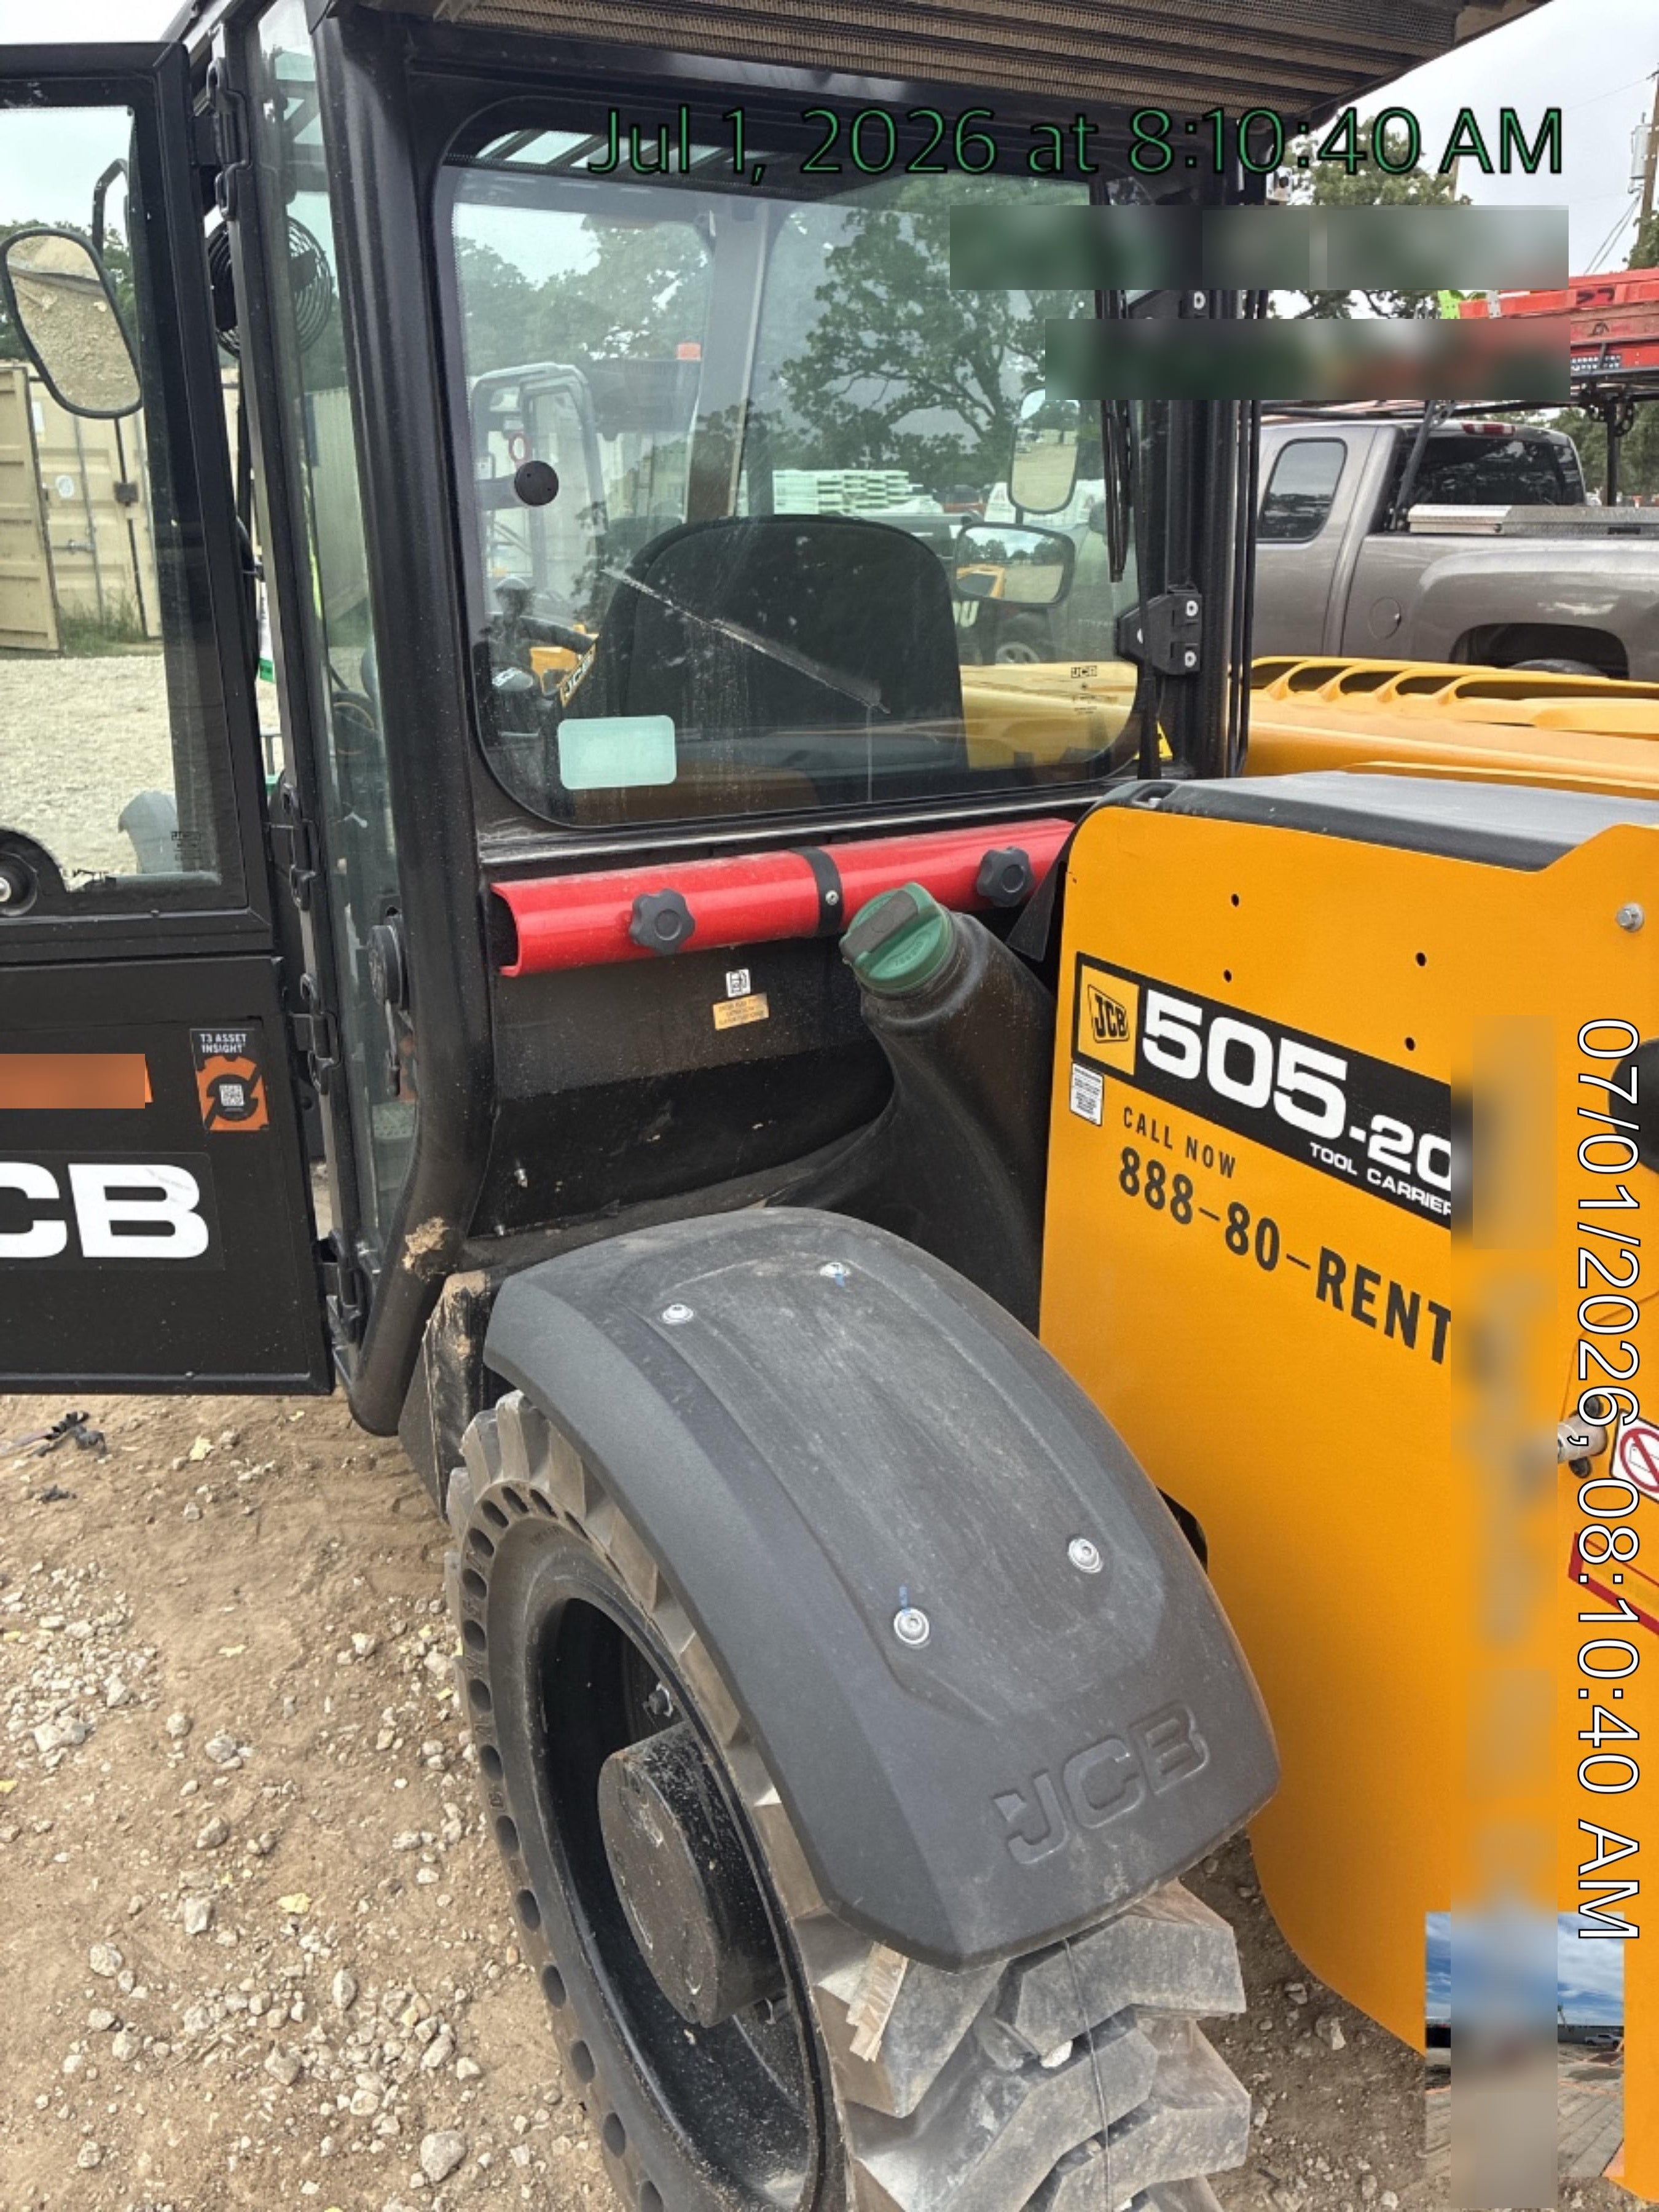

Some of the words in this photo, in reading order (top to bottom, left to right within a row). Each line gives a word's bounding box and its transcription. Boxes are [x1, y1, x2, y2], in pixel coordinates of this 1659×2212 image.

[199, 1033, 213, 1043] T3
[215, 1033, 247, 1043] ASSET
[1094, 993, 1128, 1038] JCB
[202, 1044, 243, 1053] INSIGHT
[1123, 1106, 1172, 1150] CALL
[1185, 1135, 1236, 1179] NOW
[1309, 1142, 1358, 1175] TOOL
[1119, 1146, 1451, 1365] 888-80-RENT
[991, 1701, 1210, 1865] JCB
